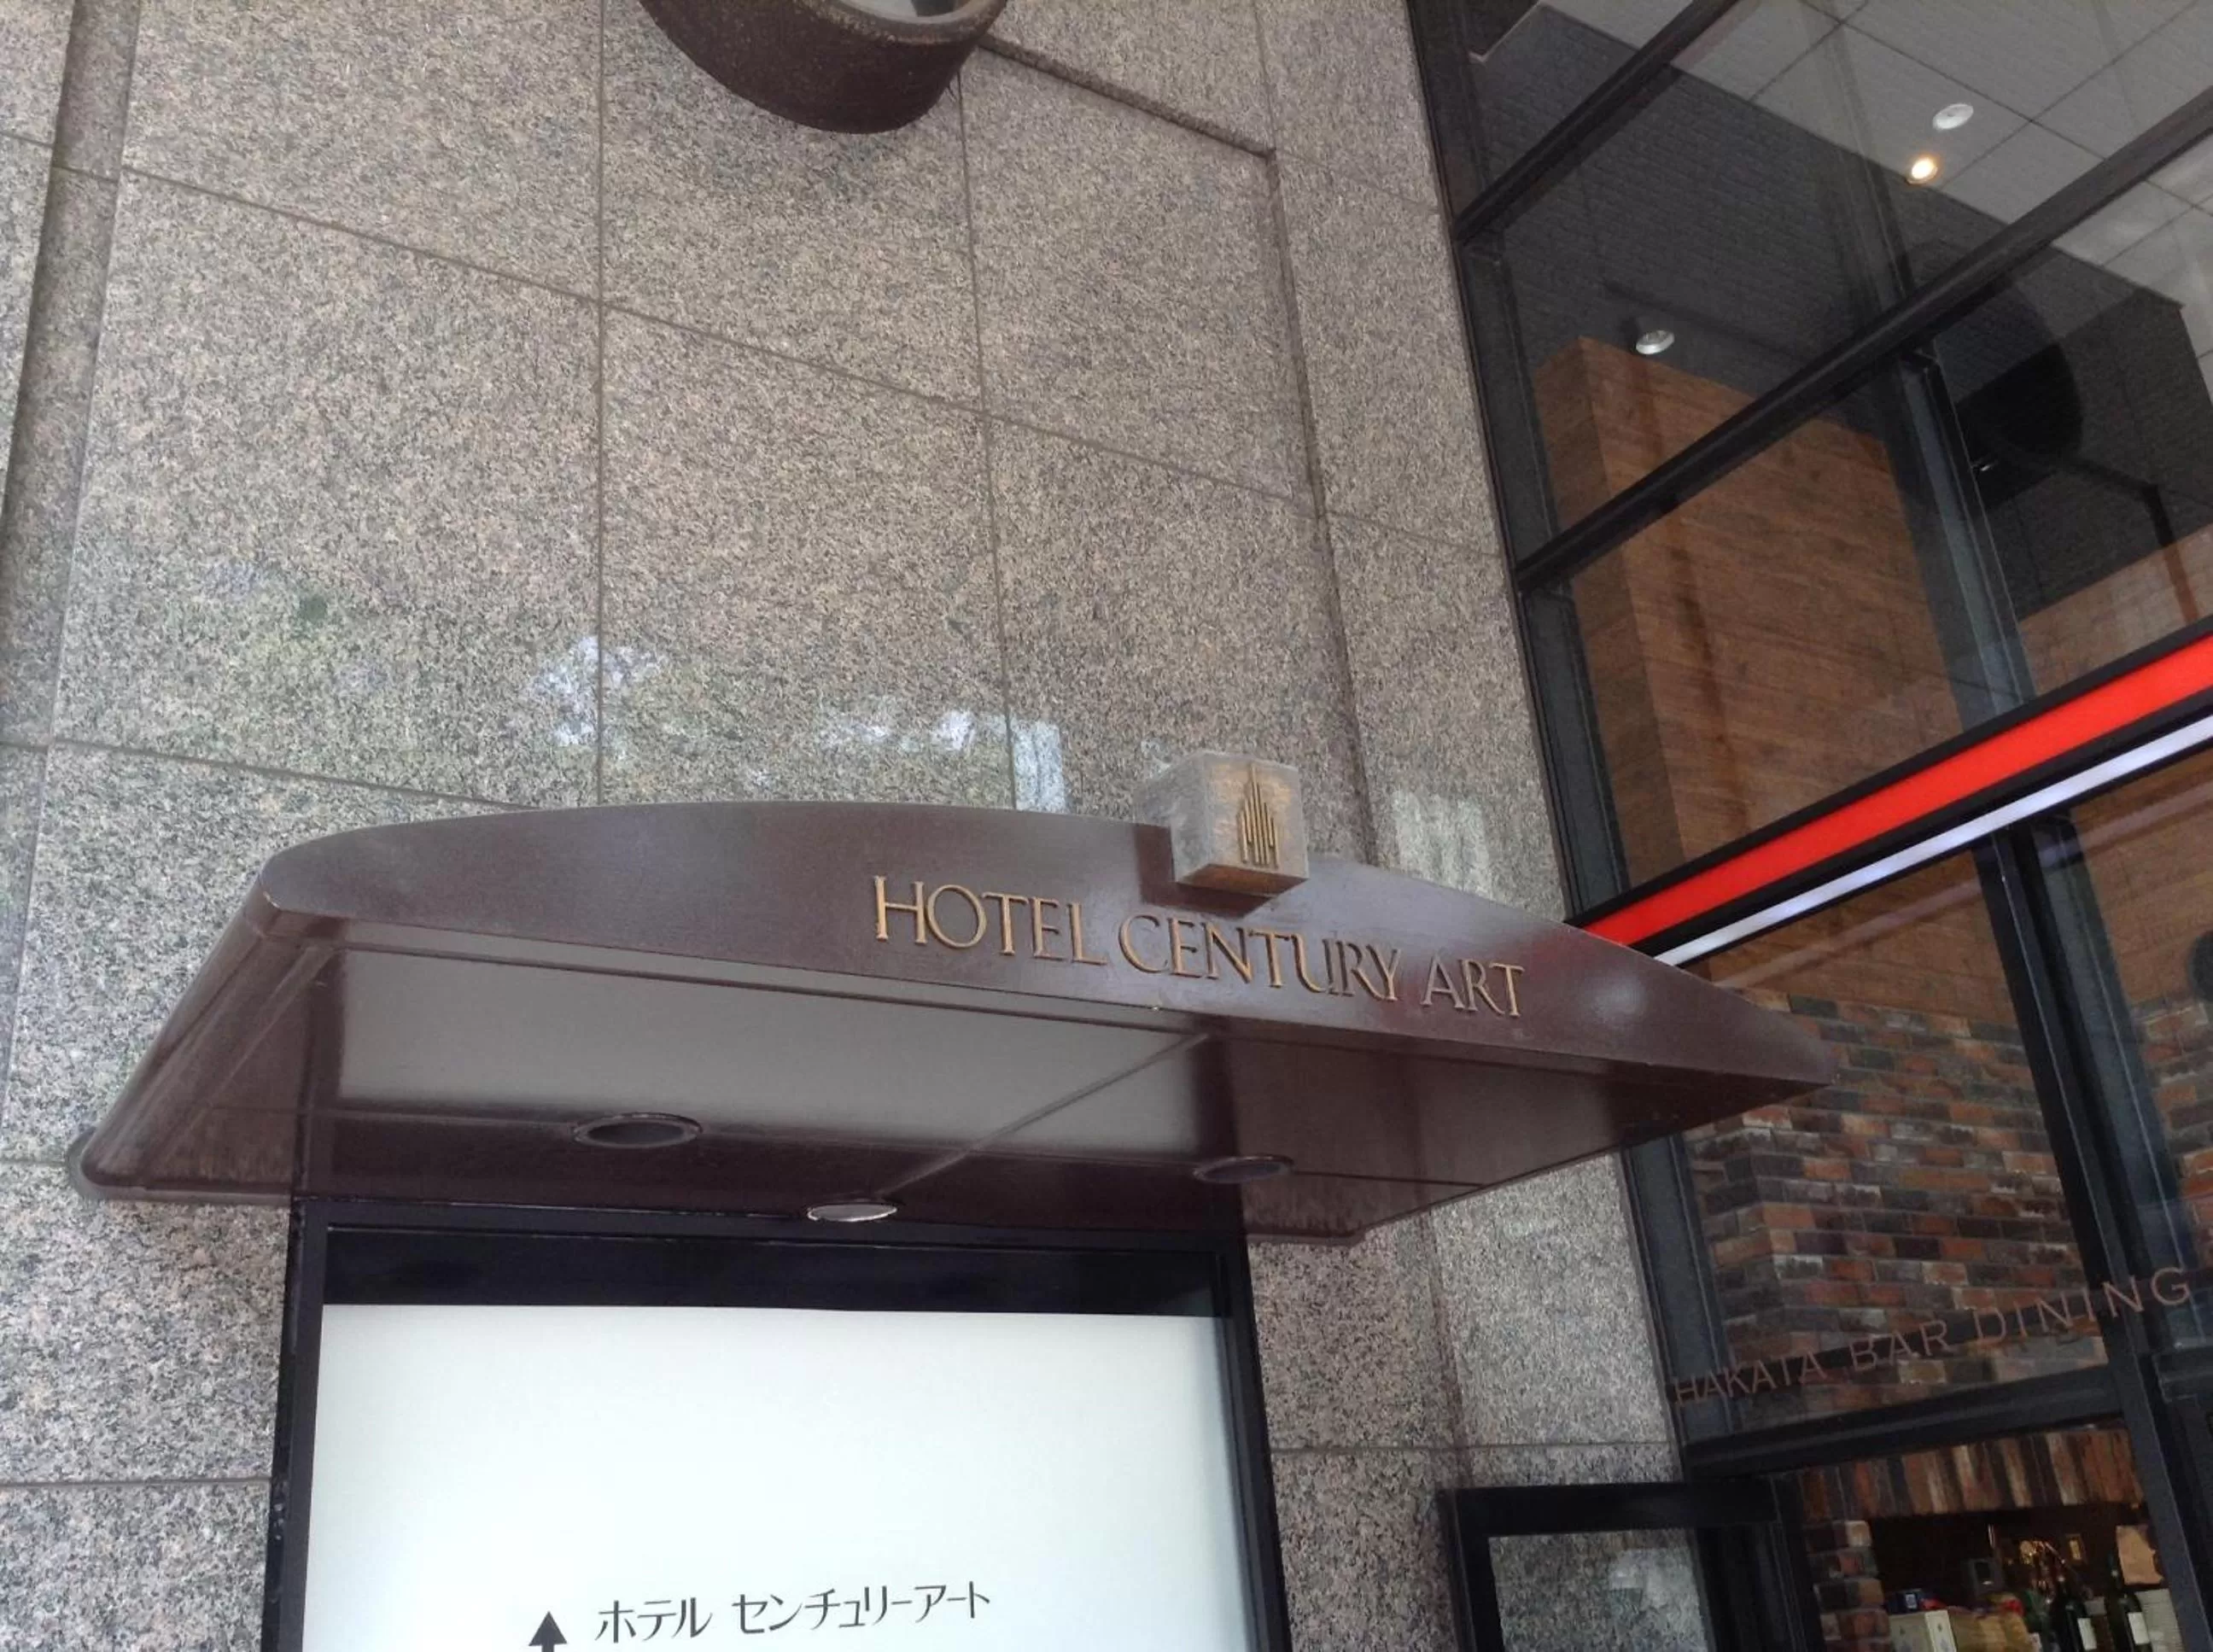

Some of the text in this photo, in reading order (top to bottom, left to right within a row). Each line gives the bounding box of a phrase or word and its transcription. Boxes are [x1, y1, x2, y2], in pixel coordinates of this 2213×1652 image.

[873, 875, 1524, 1018] HOTEL CENTURY ART
[1673, 1266, 2191, 1404] HAKATA BAR DINING
[594, 1580, 990, 1644] ホテル センチュリーアート
